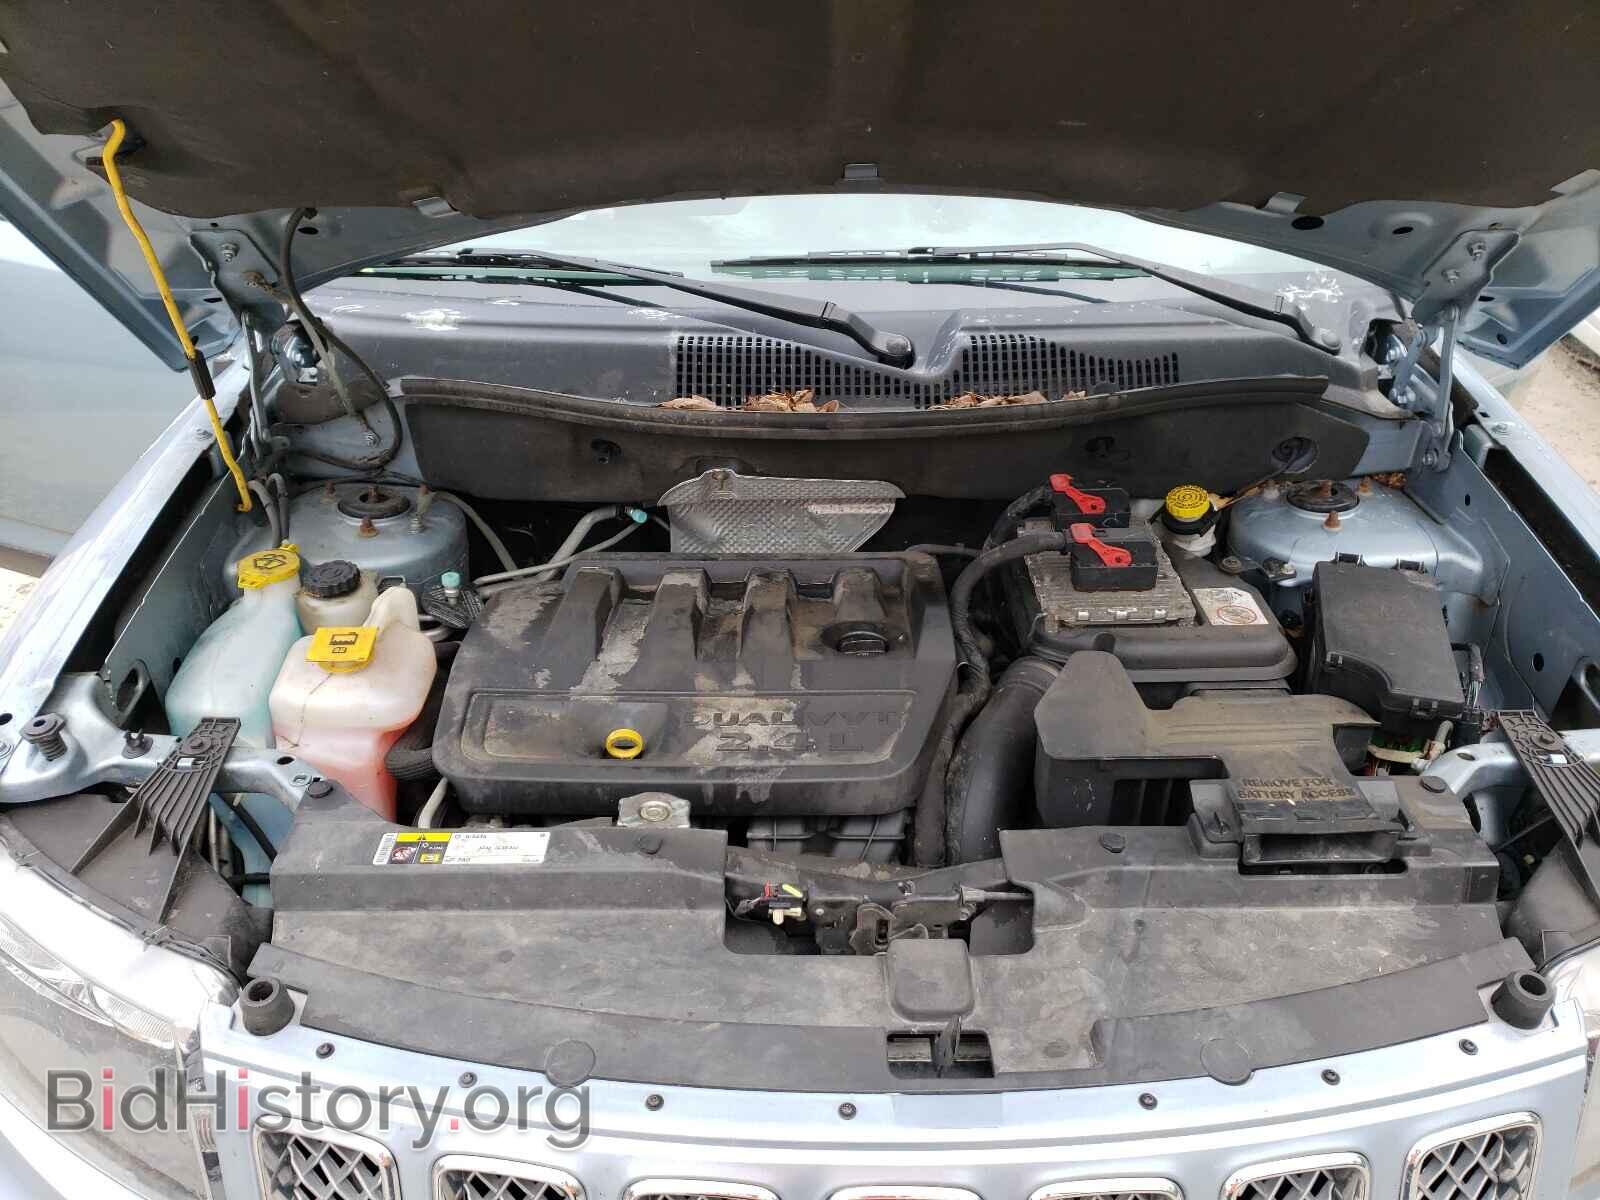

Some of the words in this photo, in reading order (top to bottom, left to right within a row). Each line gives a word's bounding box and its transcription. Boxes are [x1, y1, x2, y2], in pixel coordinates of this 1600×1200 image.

[686, 711, 797, 726] DUAL
[805, 711, 897, 726] VVT
[716, 732, 808, 751] 2.4
[1241, 777, 1300, 789] REMOVE
[1303, 777, 1334, 788] FOR
[1238, 789, 1297, 800] BATTERY
[1301, 788, 1355, 800] ACCESS
